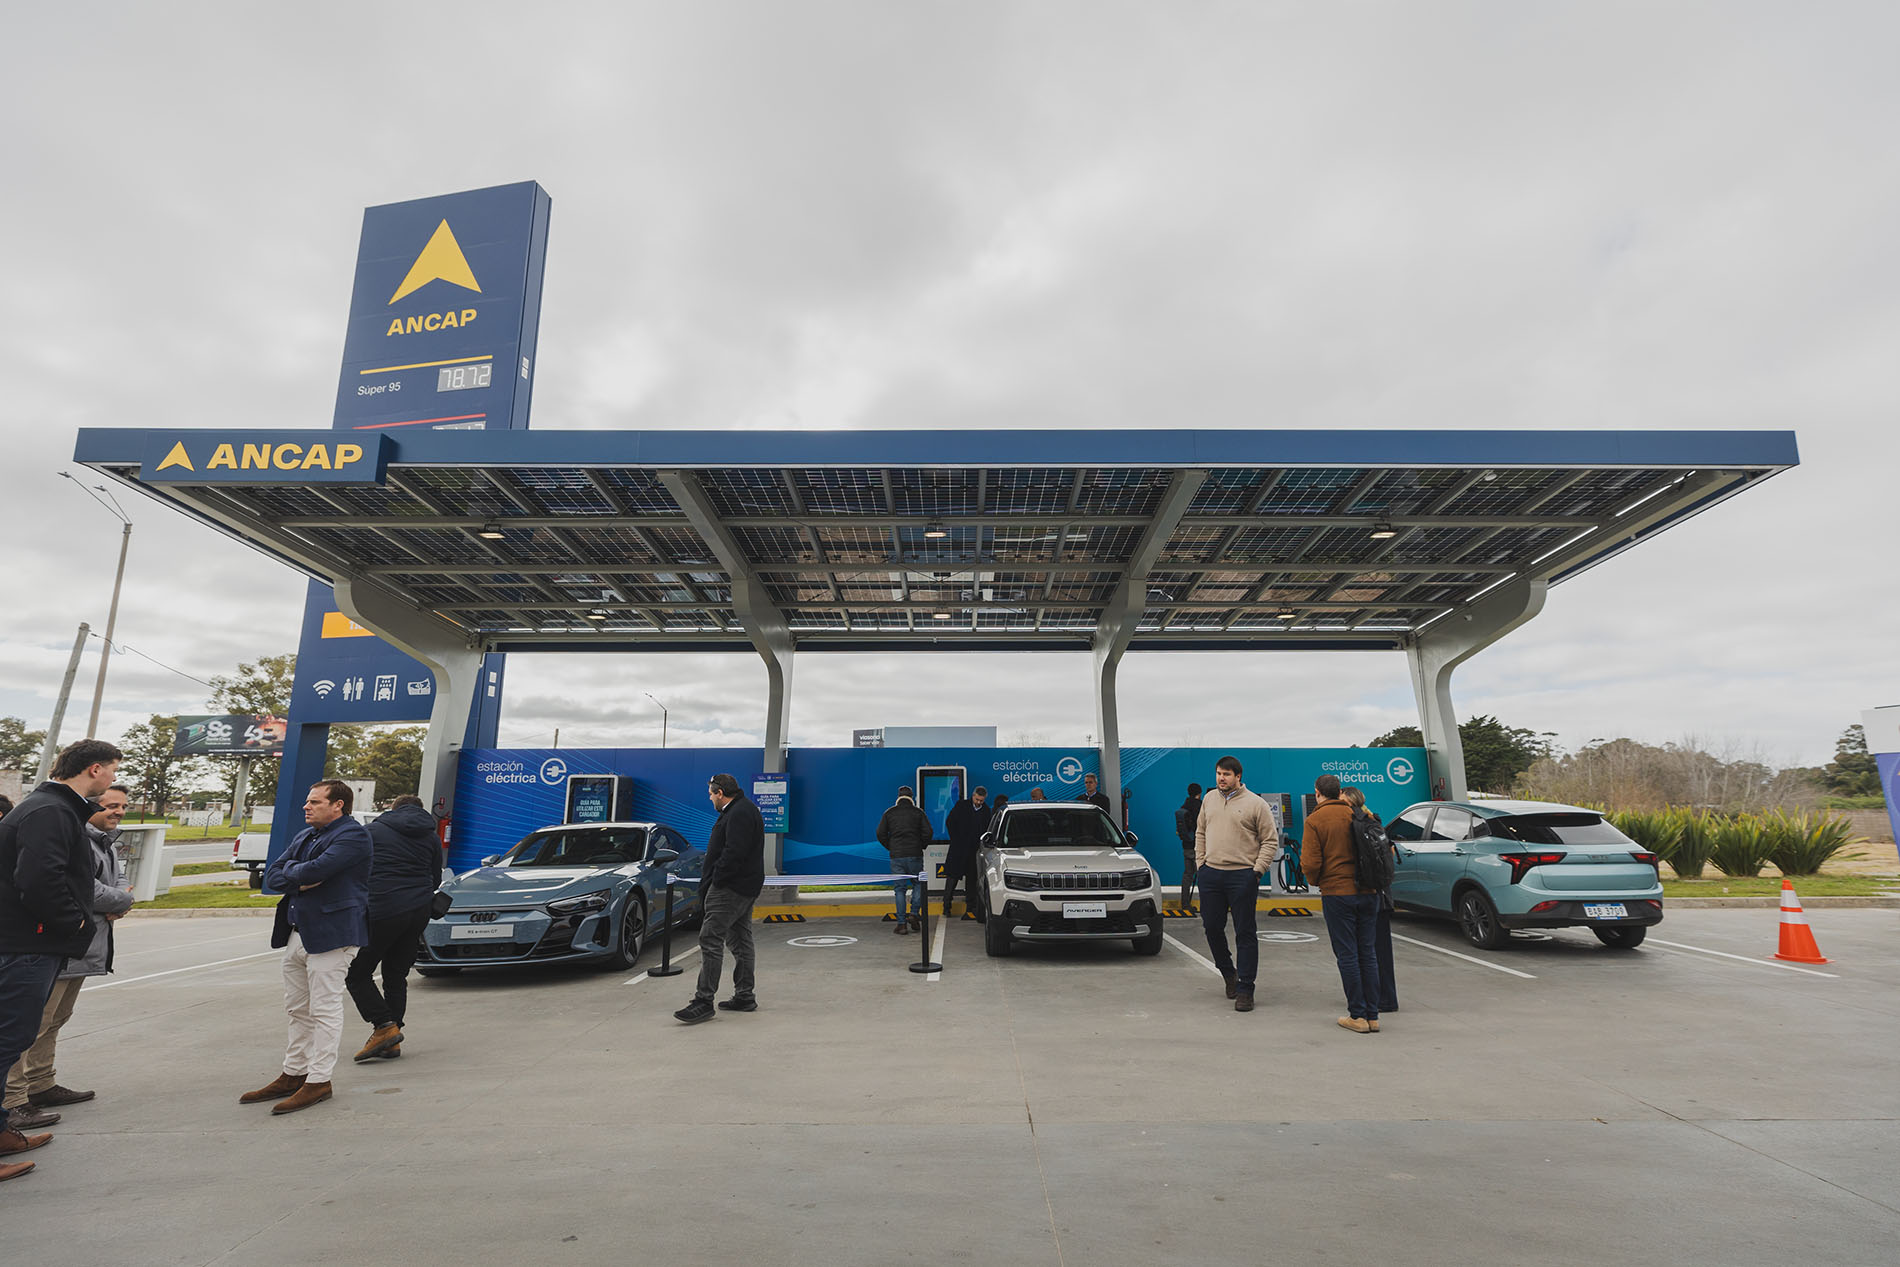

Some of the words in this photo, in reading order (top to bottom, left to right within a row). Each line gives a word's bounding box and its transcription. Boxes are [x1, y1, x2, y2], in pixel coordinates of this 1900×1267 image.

[386, 308, 477, 336] ANCAP
[442, 365, 490, 388] 78.72
[357, 384, 386, 396] Súper
[388, 381, 401, 393] 95
[206, 443, 363, 470] ANCAP
[476, 760, 524, 772] estación
[992, 759, 1039, 770] estación
[1321, 759, 1369, 770] estación
[485, 773, 537, 783] eléctrica
[1002, 771, 1054, 782] eléctrica
